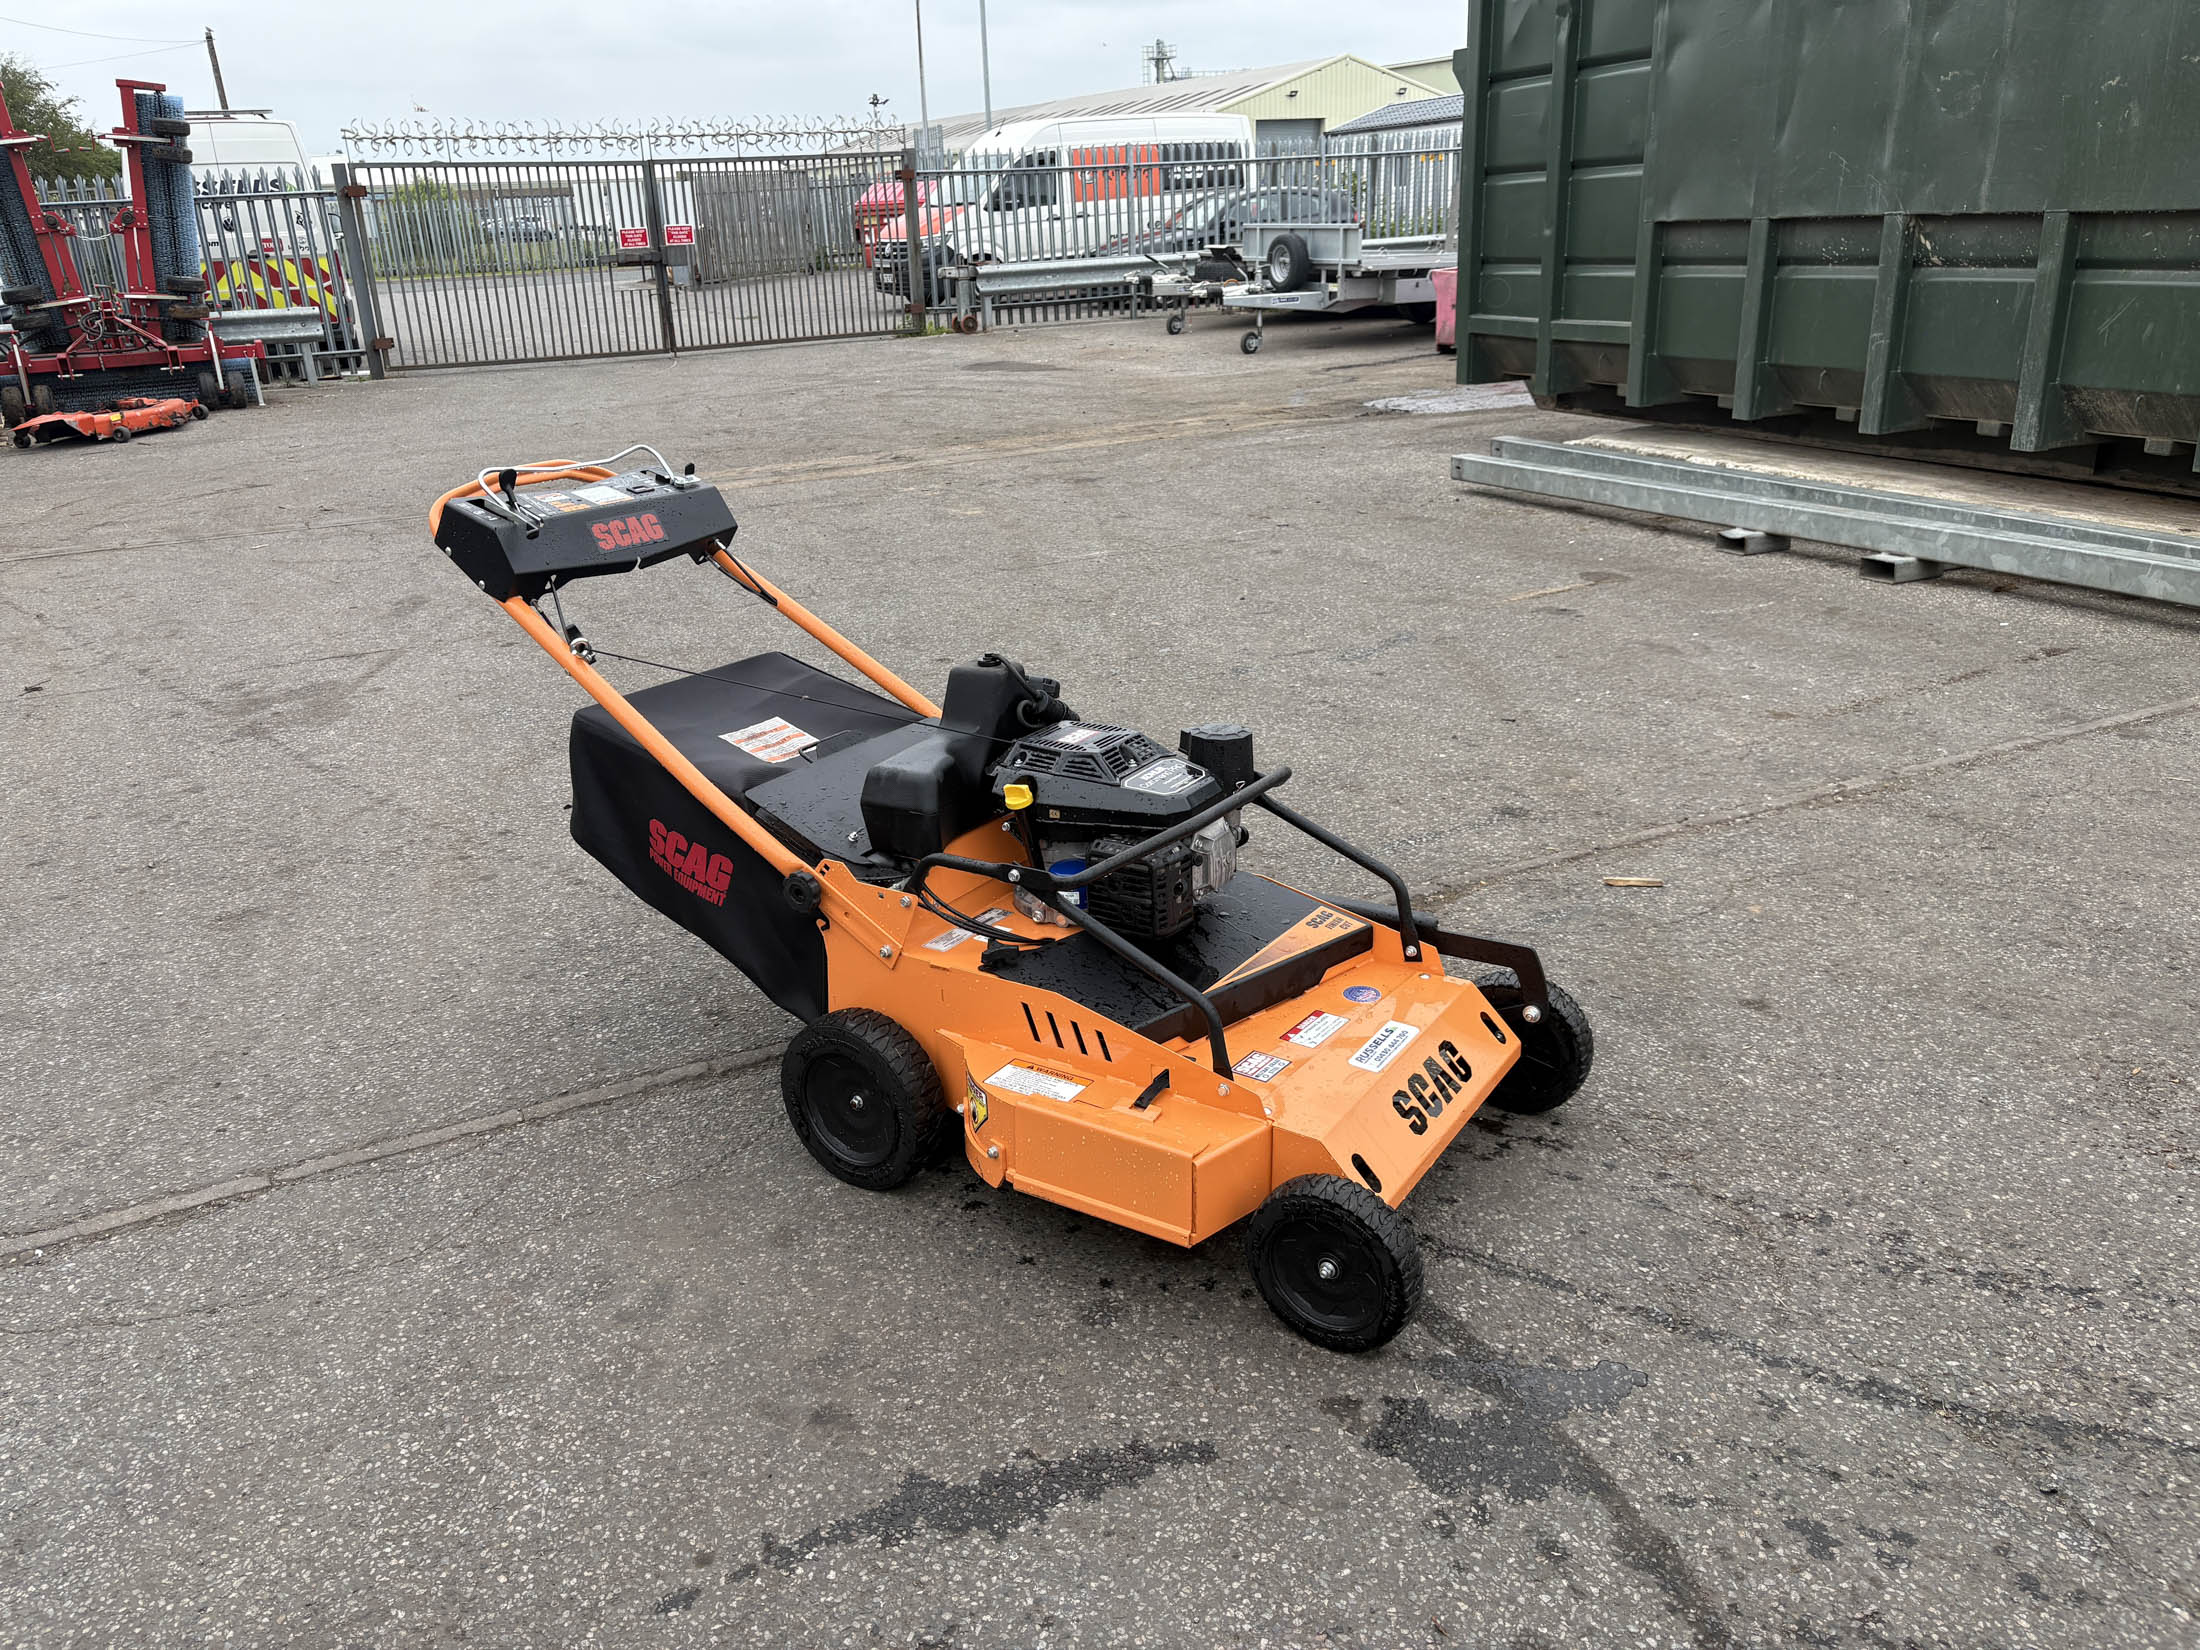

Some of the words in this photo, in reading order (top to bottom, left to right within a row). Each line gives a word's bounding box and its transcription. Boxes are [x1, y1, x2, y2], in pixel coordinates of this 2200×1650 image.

[591, 513, 665, 551] SCAG
[649, 818, 734, 892] SCAG
[673, 867, 728, 907] EQUIPMENT
[1305, 910, 1334, 929] SCAG
[1355, 1027, 1395, 1063] RUSSELLS
[1036, 1064, 1076, 1081] WARNING
[1392, 1039, 1473, 1136] SCAG
